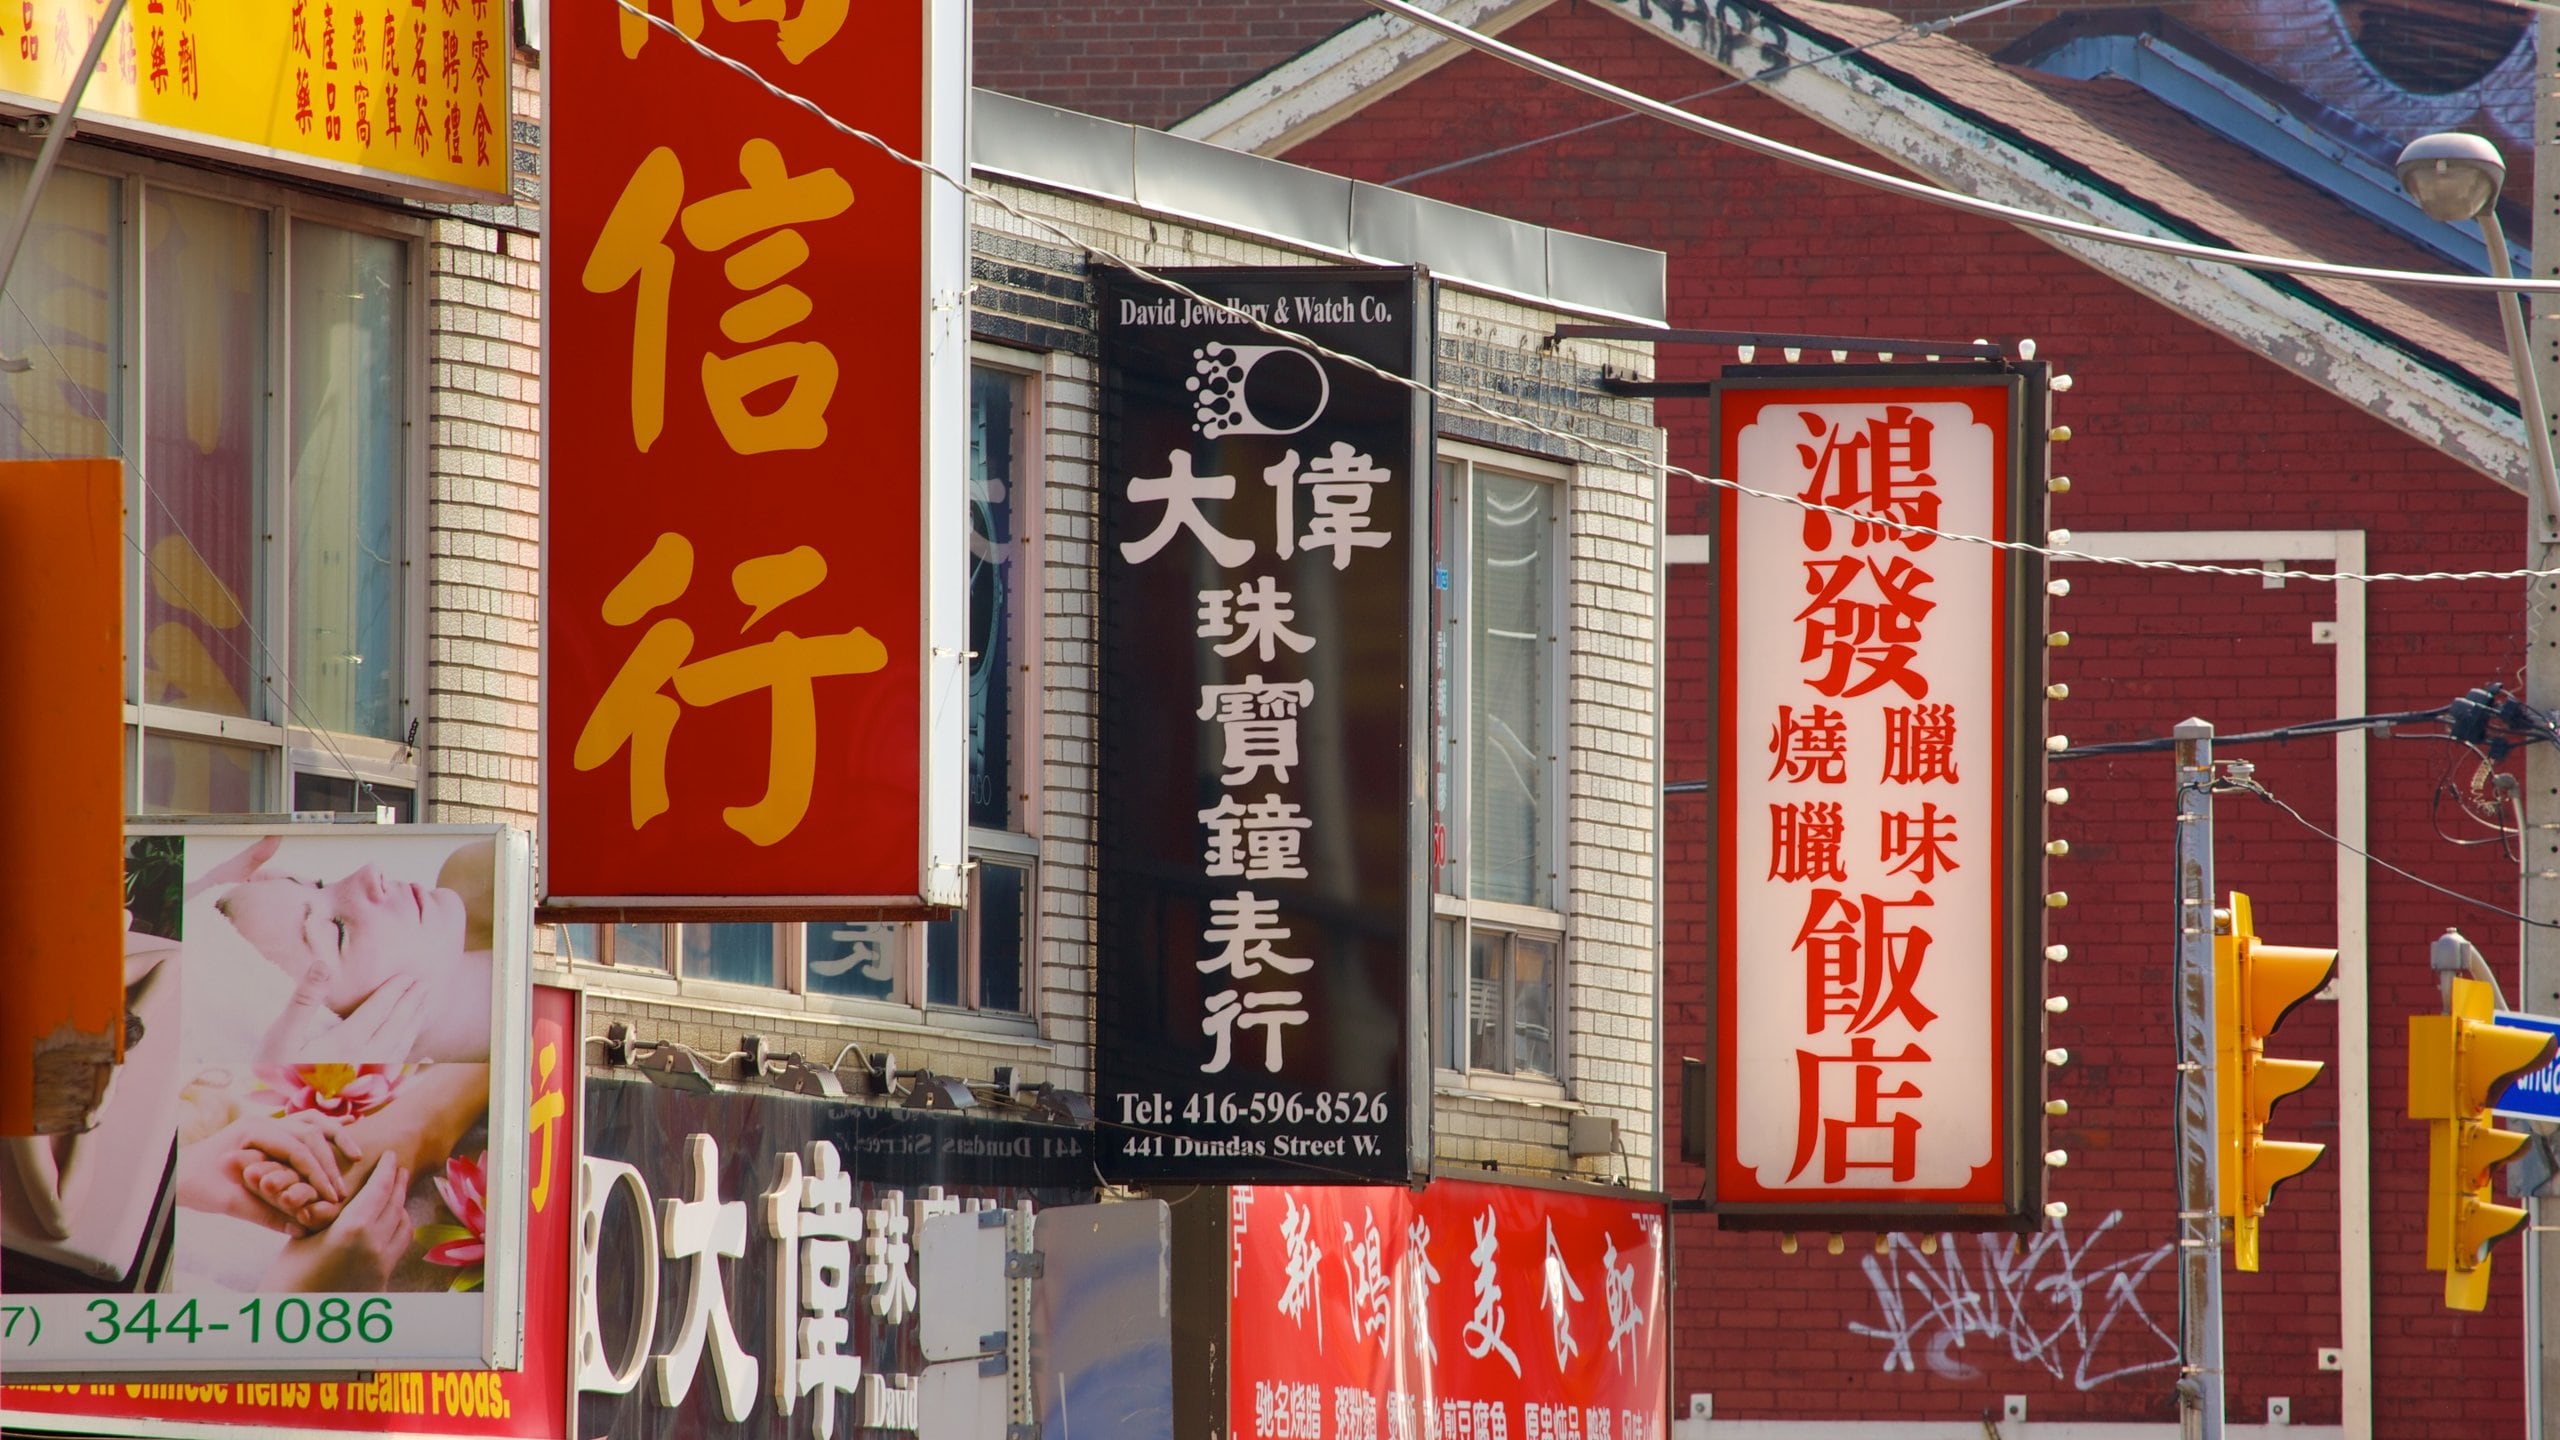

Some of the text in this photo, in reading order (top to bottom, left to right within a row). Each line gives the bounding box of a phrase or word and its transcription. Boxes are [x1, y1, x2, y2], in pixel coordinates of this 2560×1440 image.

[147, 0, 169, 95] 藥
[322, 2, 341, 141] 產品
[352, 9, 371, 149] 燕窩
[382, 8, 402, 149] 鹿茸
[411, 0, 432, 158] 茗茶
[1119, 295, 1392, 328] David Jewellery & Watch Co.
[572, 0, 888, 846] 信行
[1116, 1091, 1388, 1124] Tel: 416-596-8526
[1122, 1135, 1382, 1157] 441 Dundas Street W.
[85, 1297, 393, 1345] 344-1086
[864, 1373, 919, 1432] David
